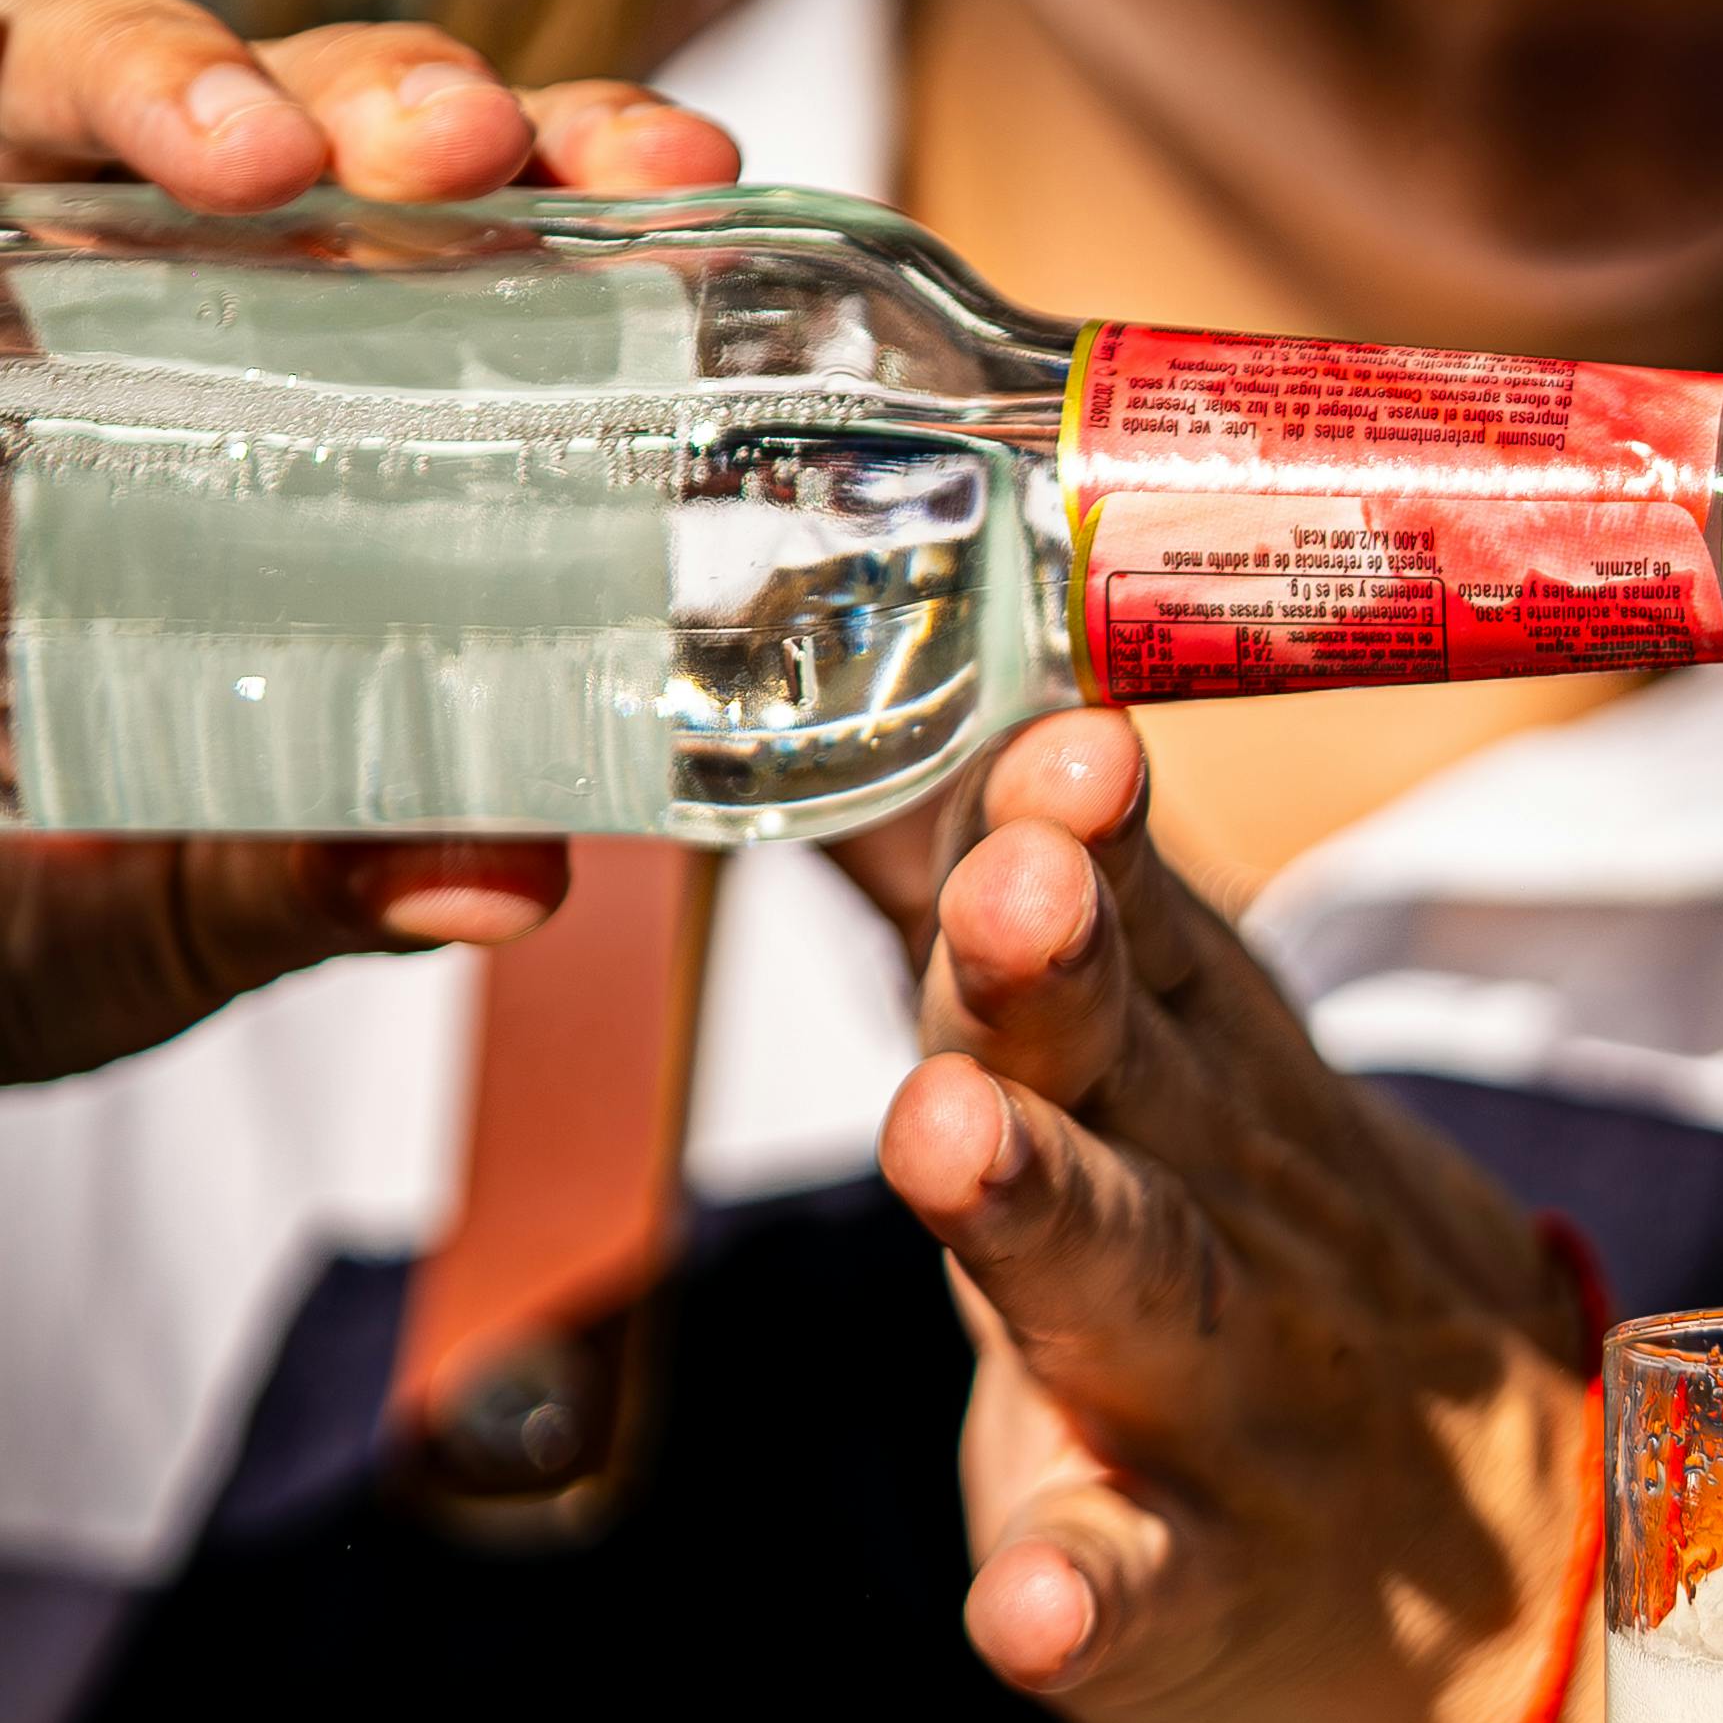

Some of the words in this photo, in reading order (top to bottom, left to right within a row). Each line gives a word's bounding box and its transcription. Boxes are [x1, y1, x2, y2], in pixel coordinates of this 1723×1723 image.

[1166, 358, 1237, 377] Company.
[1243, 364, 1318, 379] Coca-Cola
[1322, 367, 1348, 381] The
[1353, 369, 1371, 382] de
[1126, 377, 1164, 391] seco.
[1168, 377, 1175, 390] y
[1376, 370, 1468, 385] autorización
[1473, 375, 1499, 386] con
[1503, 376, 1574, 391] Envasado
[1180, 380, 1226, 396] fresco
[1230, 379, 1279, 398] limpio,
[1285, 382, 1321, 399] lugar
[1327, 386, 1344, 397] en
[1349, 386, 1422, 404] Conservar
[1426, 388, 1501, 405] agresivos.
[1126, 396, 1196, 415] Preservar
[1202, 398, 1241, 415] solar.
[1248, 400, 1268, 417] luz
[1505, 393, 1550, 408] olores
[1556, 395, 1573, 410] de
[1275, 401, 1287, 419] la
[1293, 402, 1310, 419] de
[1316, 400, 1378, 422] Proteger
[1384, 406, 1439, 421] envase.
[1444, 408, 1457, 424] el
[1463, 409, 1503, 427] sobre
[1123, 415, 1178, 437] leyenda
[1188, 420, 1211, 436] ver
[1510, 410, 1569, 429] impresa
[1221, 421, 1256, 439] Lote:
[1283, 423, 1304, 441] del
[1315, 424, 1354, 443] antes
[1365, 426, 1485, 447] preferentemente
[1495, 431, 1565, 452] Consumir
[1290, 525, 1326, 549] kcal).
[1331, 530, 1389, 550] kJ/2.000
[1394, 527, 1435, 550] (8.400
[1163, 551, 1202, 570] medio
[1208, 552, 1249, 571] adulto
[1254, 553, 1270, 567] un
[1274, 554, 1290, 572] de
[1295, 553, 1362, 573] referencia
[1367, 555, 1382, 573] de
[1590, 557, 1648, 580] jazmín.
[1653, 561, 1671, 580] de
[1286, 579, 1299, 597] g.
[1303, 583, 1311, 600] 0
[1316, 583, 1330, 596] es
[1335, 583, 1354, 600] sal
[1358, 580, 1366, 597] y
[1370, 582, 1433, 602] proteínas
[1458, 582, 1523, 599] extracto
[1528, 581, 1538, 597] y
[1542, 585, 1617, 601] naturales
[1623, 585, 1681, 600] aromas
[1154, 599, 1225, 619] saturadas,
[1229, 601, 1274, 617] grasas
[1277, 601, 1327, 618] grasas,
[1331, 605, 1347, 621] de
[1352, 605, 1417, 622] contenido
[1422, 607, 1434, 624] El
[1470, 603, 1521, 623] E-330,
[1527, 606, 1610, 622] acidulante
[1615, 604, 1686, 623] fructosa,
[1351, 631, 1392, 646] cuales
[1395, 632, 1414, 646] los
[1418, 632, 1432, 646] de
[1523, 624, 1580, 641] azúcar,
[1586, 622, 1690, 639] carbonatada,
